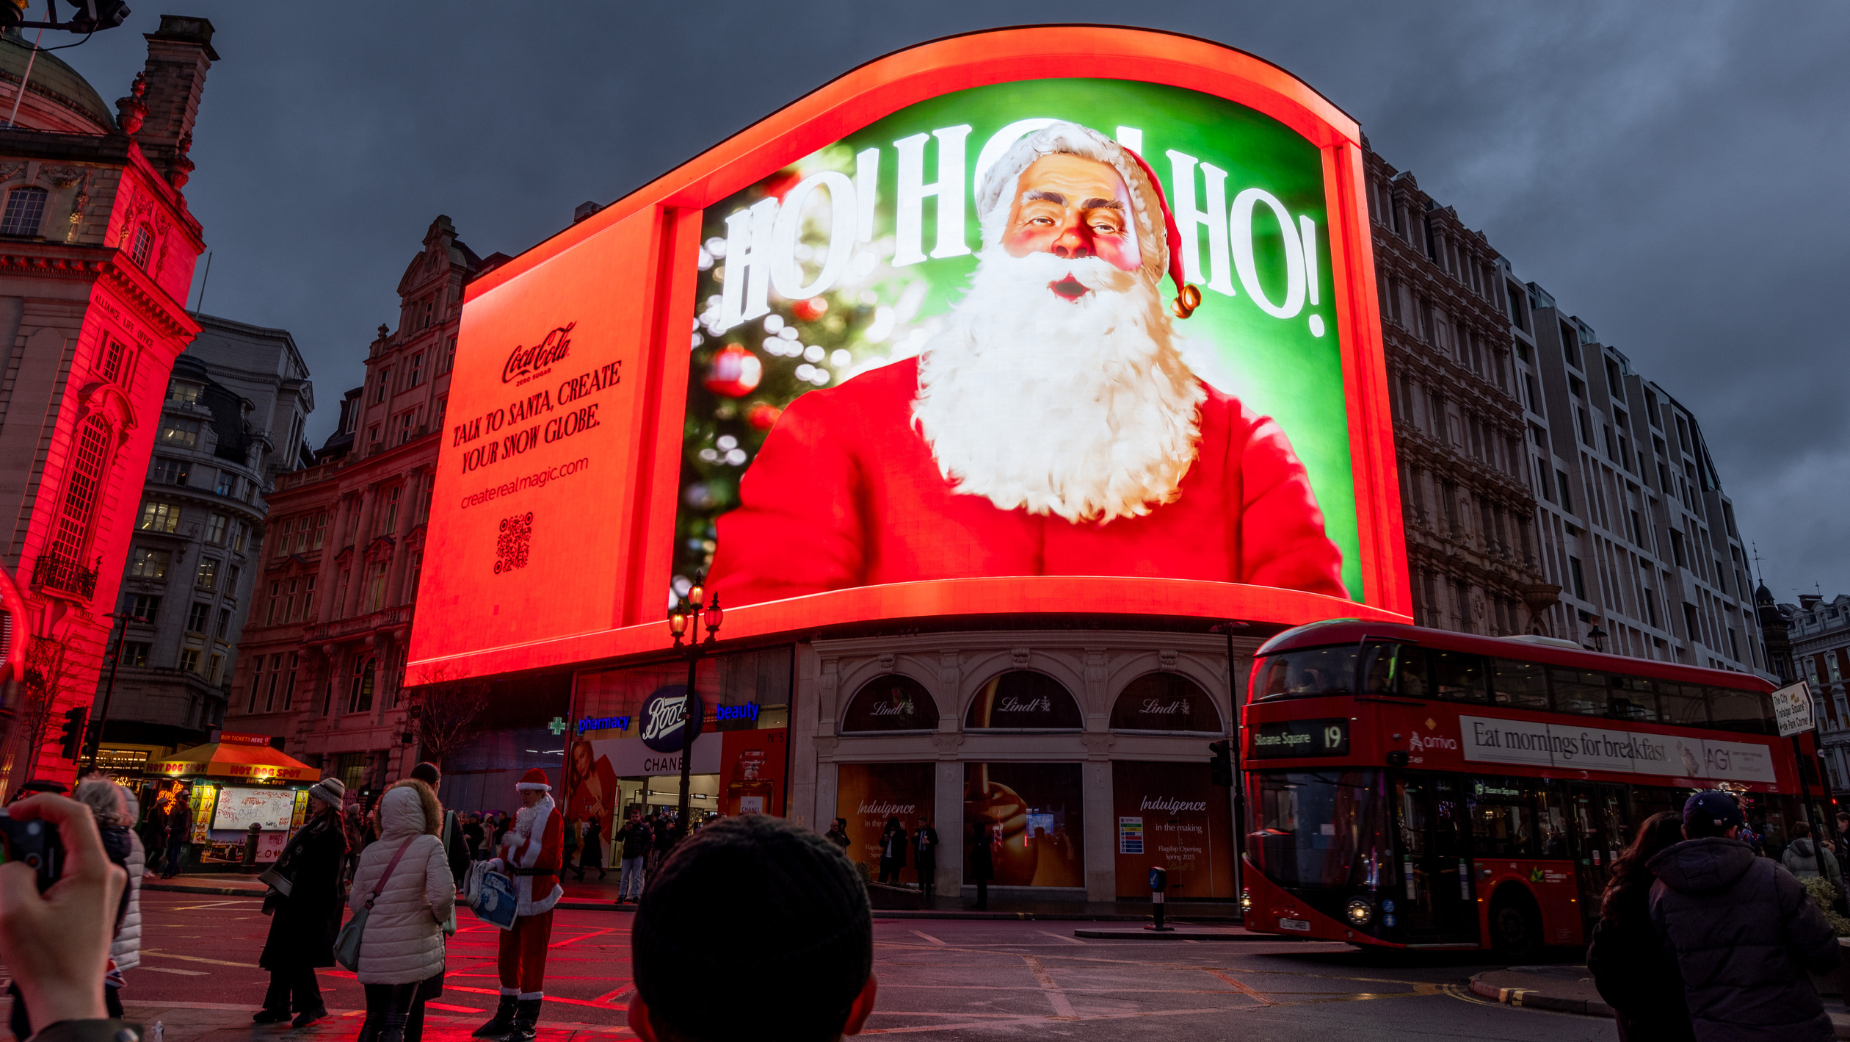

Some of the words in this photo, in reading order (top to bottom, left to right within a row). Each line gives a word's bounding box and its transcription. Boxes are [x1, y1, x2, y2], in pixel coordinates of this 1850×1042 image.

[715, 147, 880, 331] HO!
[1166, 149, 1325, 338] HO!
[94, 293, 120, 320] ALLIANCE
[123, 316, 135, 332] LIFE
[137, 330, 154, 349] OFFICE
[502, 321, 577, 384] Coca-Cola
[516, 376, 531, 387] ZERO
[532, 367, 552, 380] SUGAR
[453, 418, 483, 447] TALK
[485, 409, 504, 435] TO
[507, 391, 554, 426] SANTA,
[557, 360, 622, 406] CREATE
[462, 440, 498, 474] YOUR
[501, 425, 540, 461] SNOW
[544, 403, 601, 445] GLOBE.
[461, 457, 588, 510] createrealmagic.com
[997, 696, 1040, 713] Lindt
[1139, 698, 1181, 715] Lindt
[1780, 693, 1788, 704] City
[642, 694, 688, 740] Boot
[716, 701, 760, 721] beauty
[869, 701, 905, 716] Lindt
[1776, 707, 1792, 719] Trafalgar
[1791, 704, 1805, 714] Square
[579, 715, 630, 734] pharmacy
[1796, 717, 1808, 728] Corner
[231, 735, 250, 743] TICKETS
[1254, 734, 1281, 746] Sloane
[1281, 732, 1311, 748] Square
[1324, 726, 1341, 748] 19
[1423, 735, 1457, 750] arriva
[1474, 722, 1500, 748] Eat
[1505, 727, 1578, 760] mornings
[1580, 732, 1602, 756] for
[1604, 733, 1666, 762] breakfast
[146, 764, 164, 773] HOT
[165, 763, 183, 773] DOG
[185, 763, 206, 772] SPOT
[644, 757, 691, 772] CHANE
[1707, 748, 1732, 771] AG1
[230, 765, 250, 775] HOT
[253, 766, 275, 777] DOG
[276, 768, 301, 778] SPOT
[857, 799, 916, 818] Indulgence
[1140, 795, 1207, 816] Indulgence
[872, 819, 882, 827] the
[1155, 823, 1162, 831] in
[1164, 823, 1176, 832] the
[1177, 824, 1203, 835] making
[1158, 845, 1179, 854] Flagship
[1179, 846, 1202, 854] Opening
[1165, 853, 1182, 861] Spring
